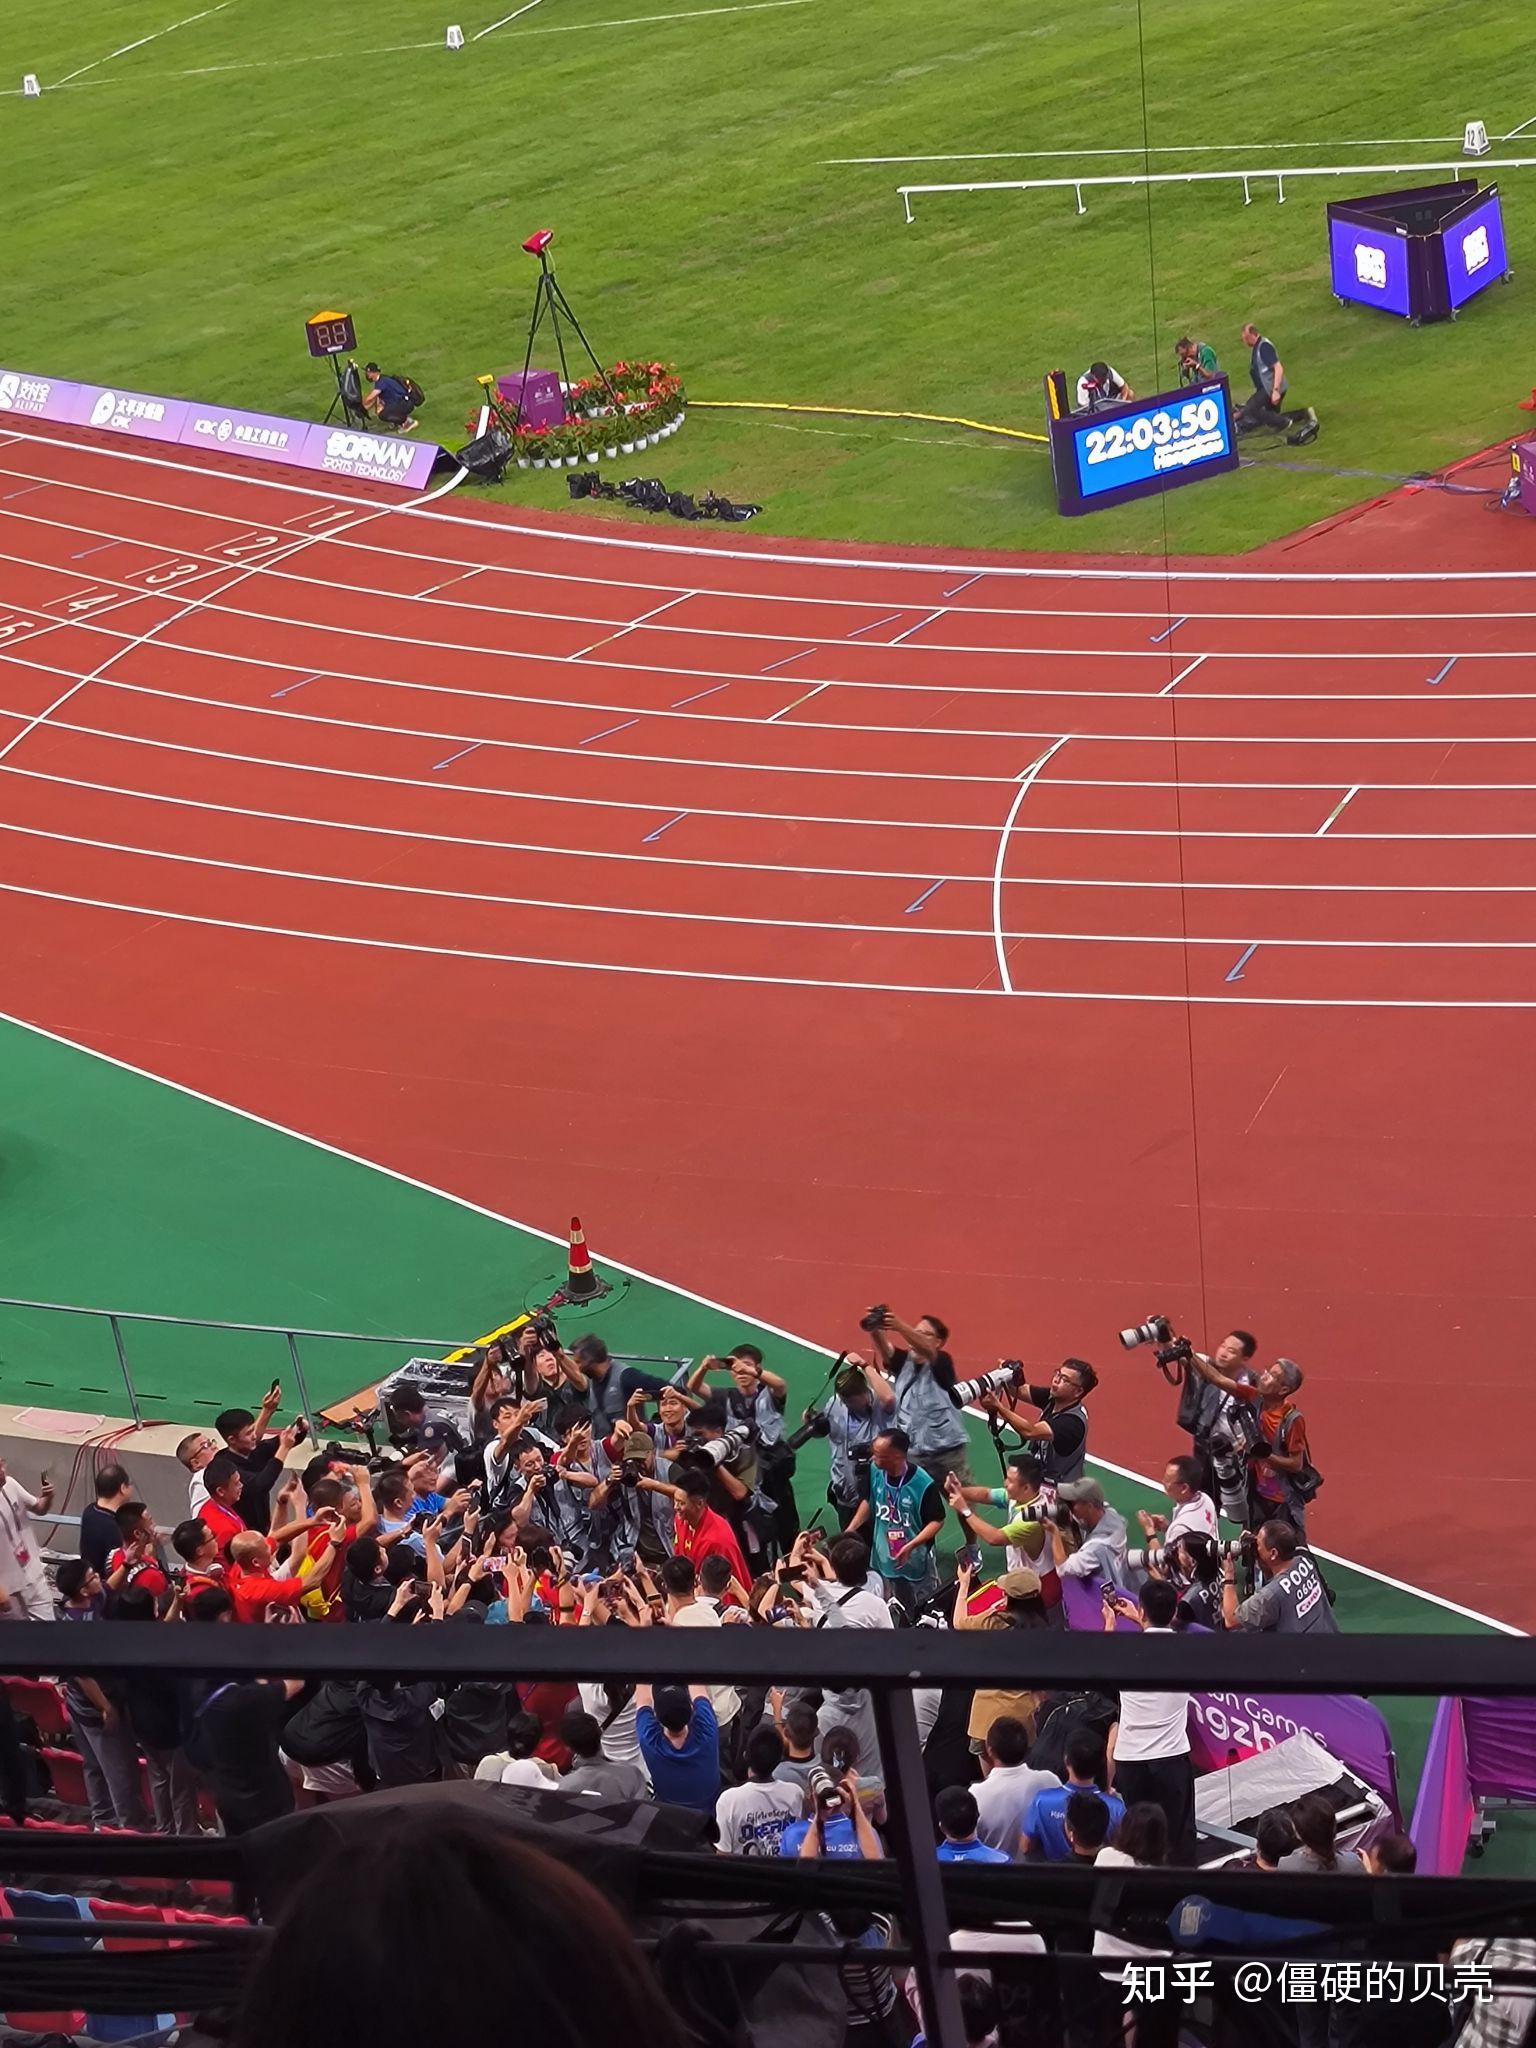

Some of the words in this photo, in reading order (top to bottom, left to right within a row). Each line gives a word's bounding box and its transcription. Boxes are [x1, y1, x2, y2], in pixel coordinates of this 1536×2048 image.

[1085, 399, 1219, 465] 22:03:50
[222, 536, 279, 557] 2
[145, 563, 199, 585] 3
[68, 593, 119, 613] 4
